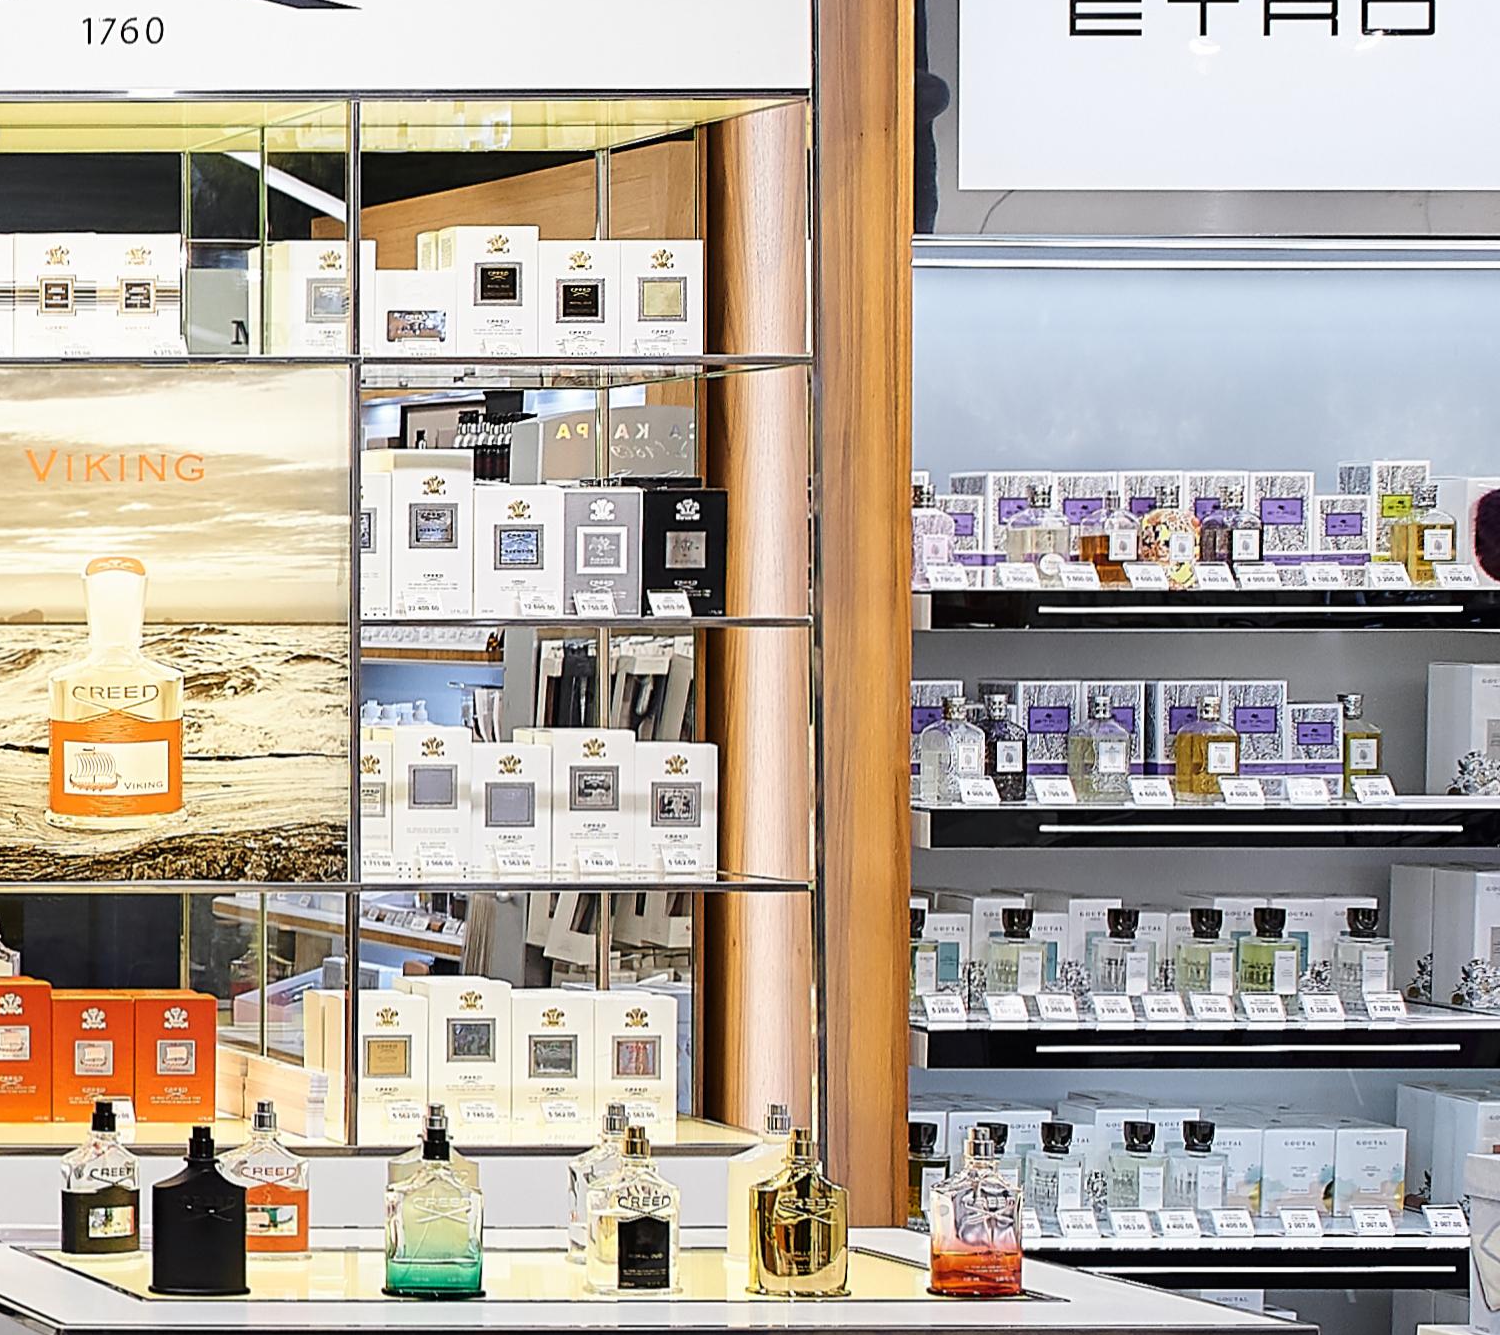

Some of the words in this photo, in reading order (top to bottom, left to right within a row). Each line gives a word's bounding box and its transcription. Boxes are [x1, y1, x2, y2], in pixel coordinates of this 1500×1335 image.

[82, 17, 165, 46] 1760
[25, 448, 205, 482] VIKING
[124, 781, 164, 791] VIKING
